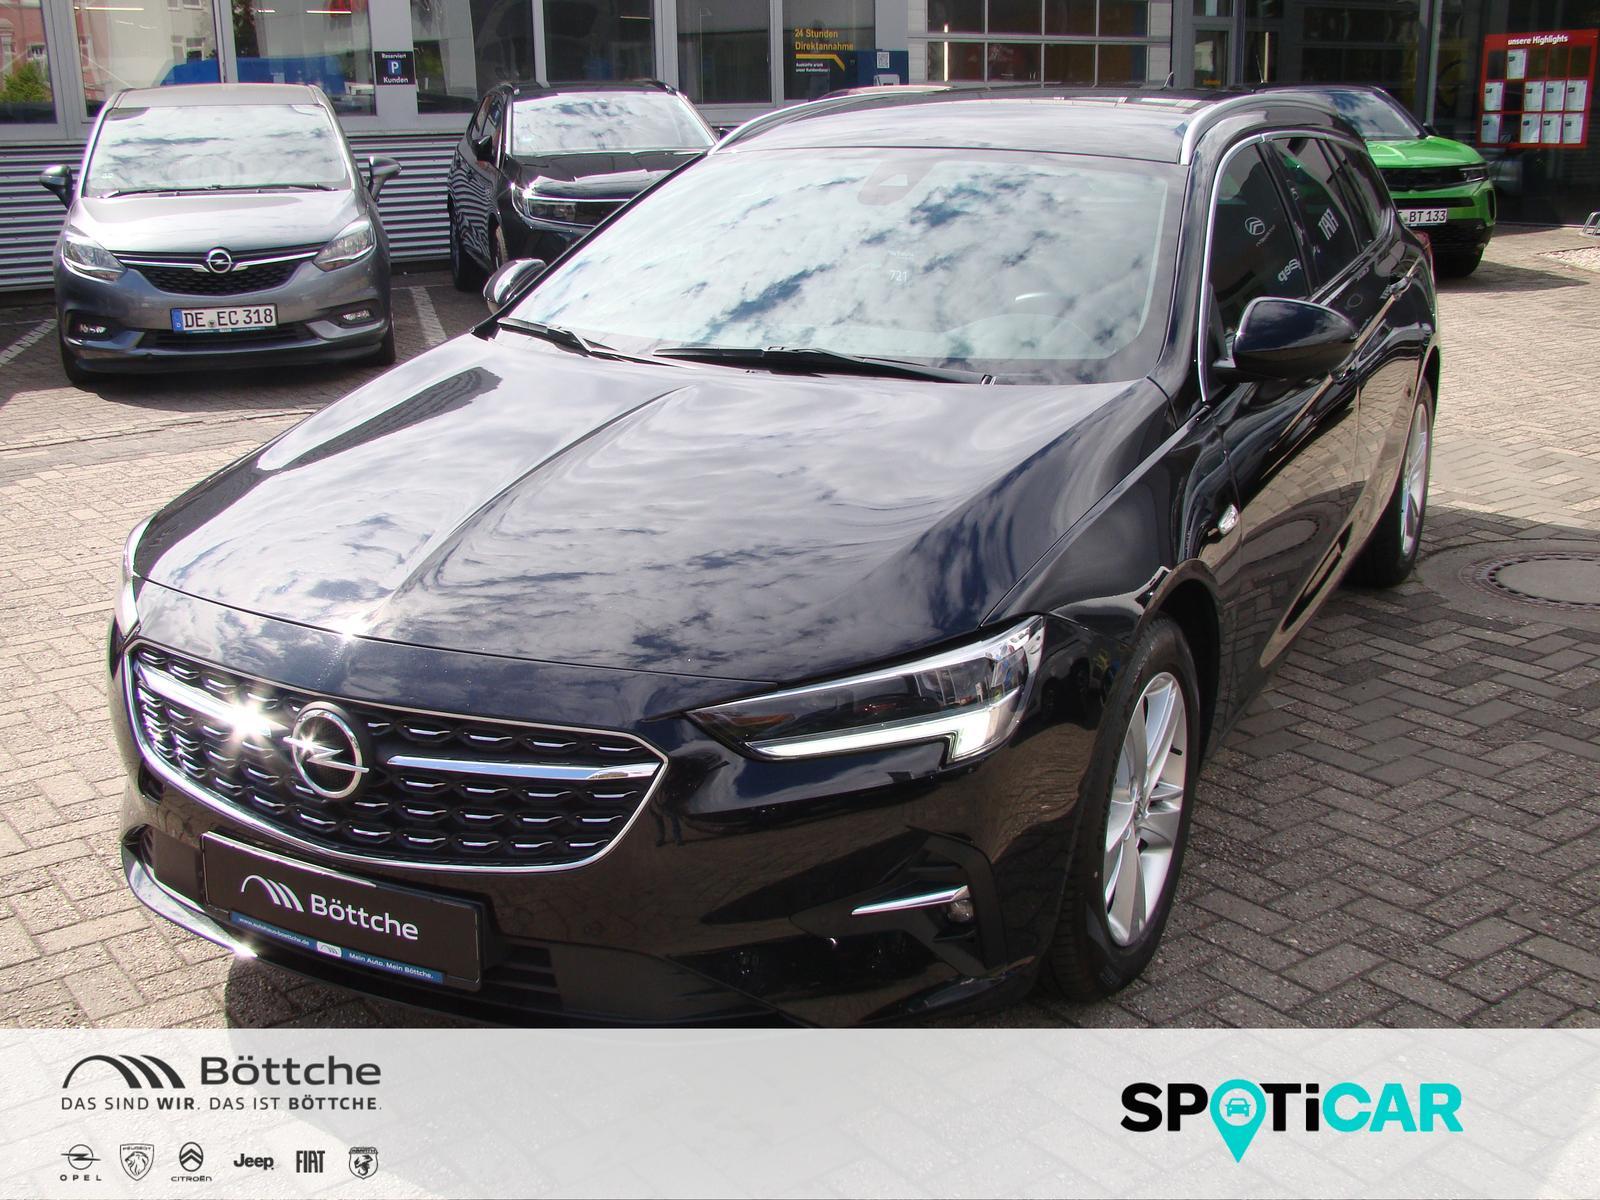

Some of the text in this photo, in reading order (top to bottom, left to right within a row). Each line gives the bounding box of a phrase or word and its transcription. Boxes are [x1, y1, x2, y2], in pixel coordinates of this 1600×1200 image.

[794, 29, 838, 38] 24 Stunden
[1532, 34, 1569, 45] Highlights
[795, 41, 854, 50] Direktannahme
[391, 61, 399, 74] P
[1409, 210, 1446, 222] BT 133
[184, 312, 206, 328] DE
[217, 310, 239, 326] EC
[243, 308, 274, 325] 318
[310, 893, 419, 941] Böttche
[349, 953, 434, 979] Mein Auto. Mein Böttche.
